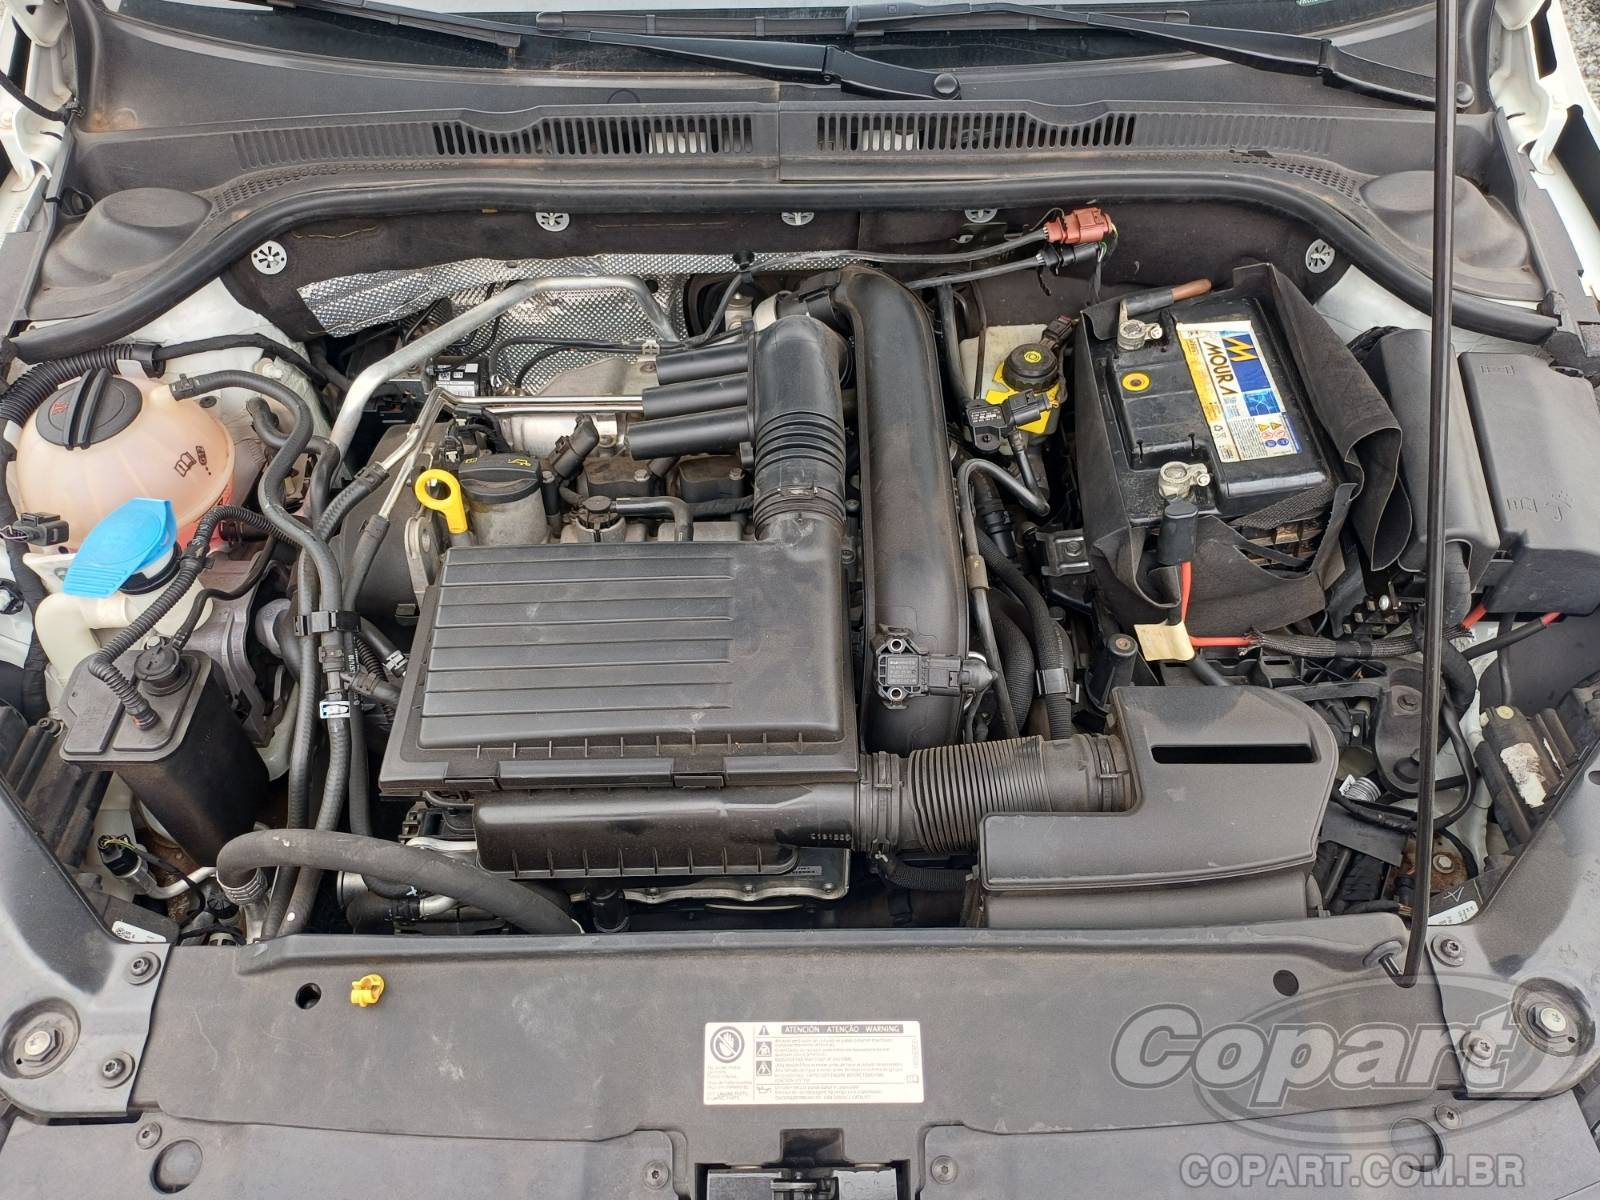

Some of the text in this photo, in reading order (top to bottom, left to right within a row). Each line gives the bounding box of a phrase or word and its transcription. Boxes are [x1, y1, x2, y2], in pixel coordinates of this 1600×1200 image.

[1203, 341, 1239, 396] MOURA
[784, 1024, 900, 1035] ATENCIÓN ATENÇÃO WARNING
